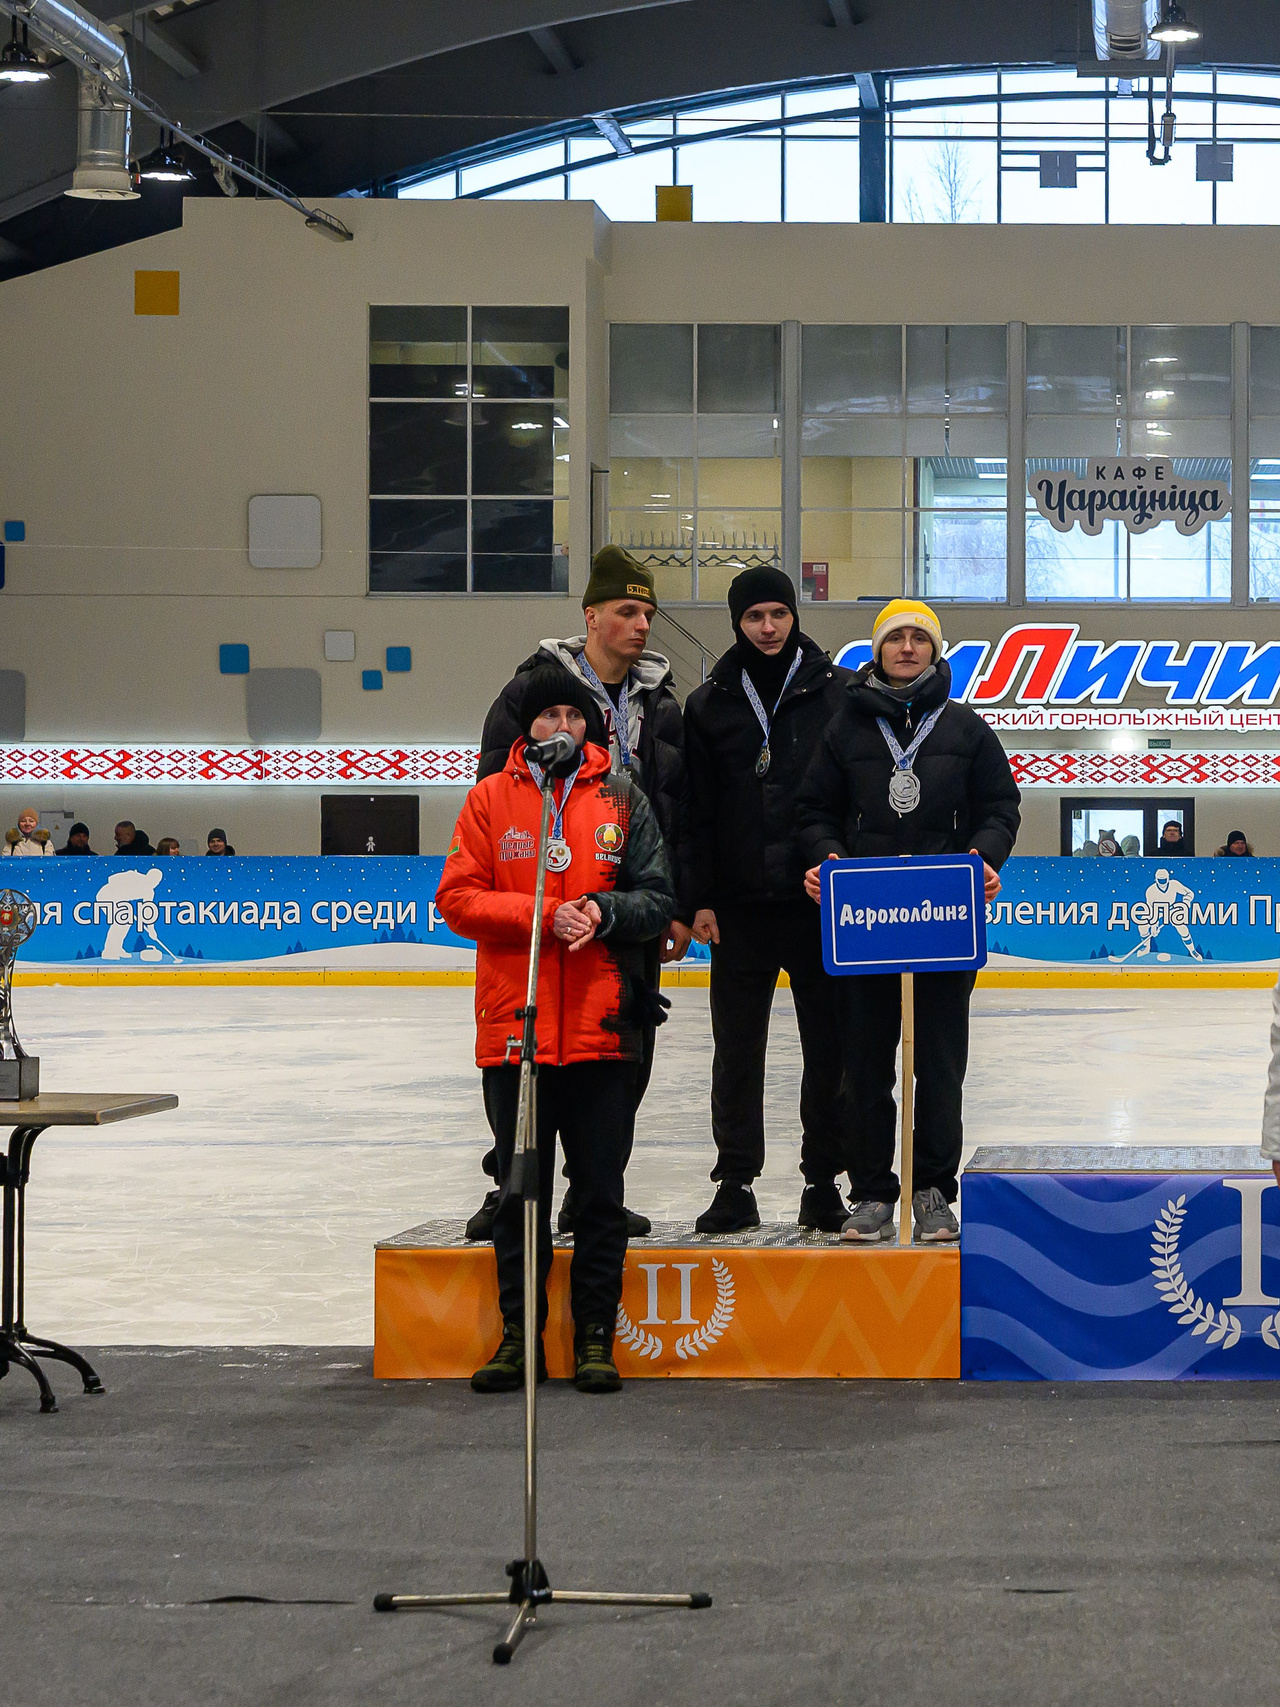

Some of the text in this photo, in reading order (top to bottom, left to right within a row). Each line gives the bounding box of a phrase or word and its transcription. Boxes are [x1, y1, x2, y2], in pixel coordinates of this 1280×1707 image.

[1095, 465, 1165, 481] КАФЕ
[1037, 479, 1223, 527] Чараўніца
[979, 710, 1044, 726] СКИЙ
[1049, 710, 1224, 726] ГОРНОЛЫЖНЫЙ
[73, 900, 301, 932] спартакиада
[311, 900, 417, 932] среди
[839, 899, 968, 931] Агрохолдинг
[1107, 901, 1239, 931] делами
